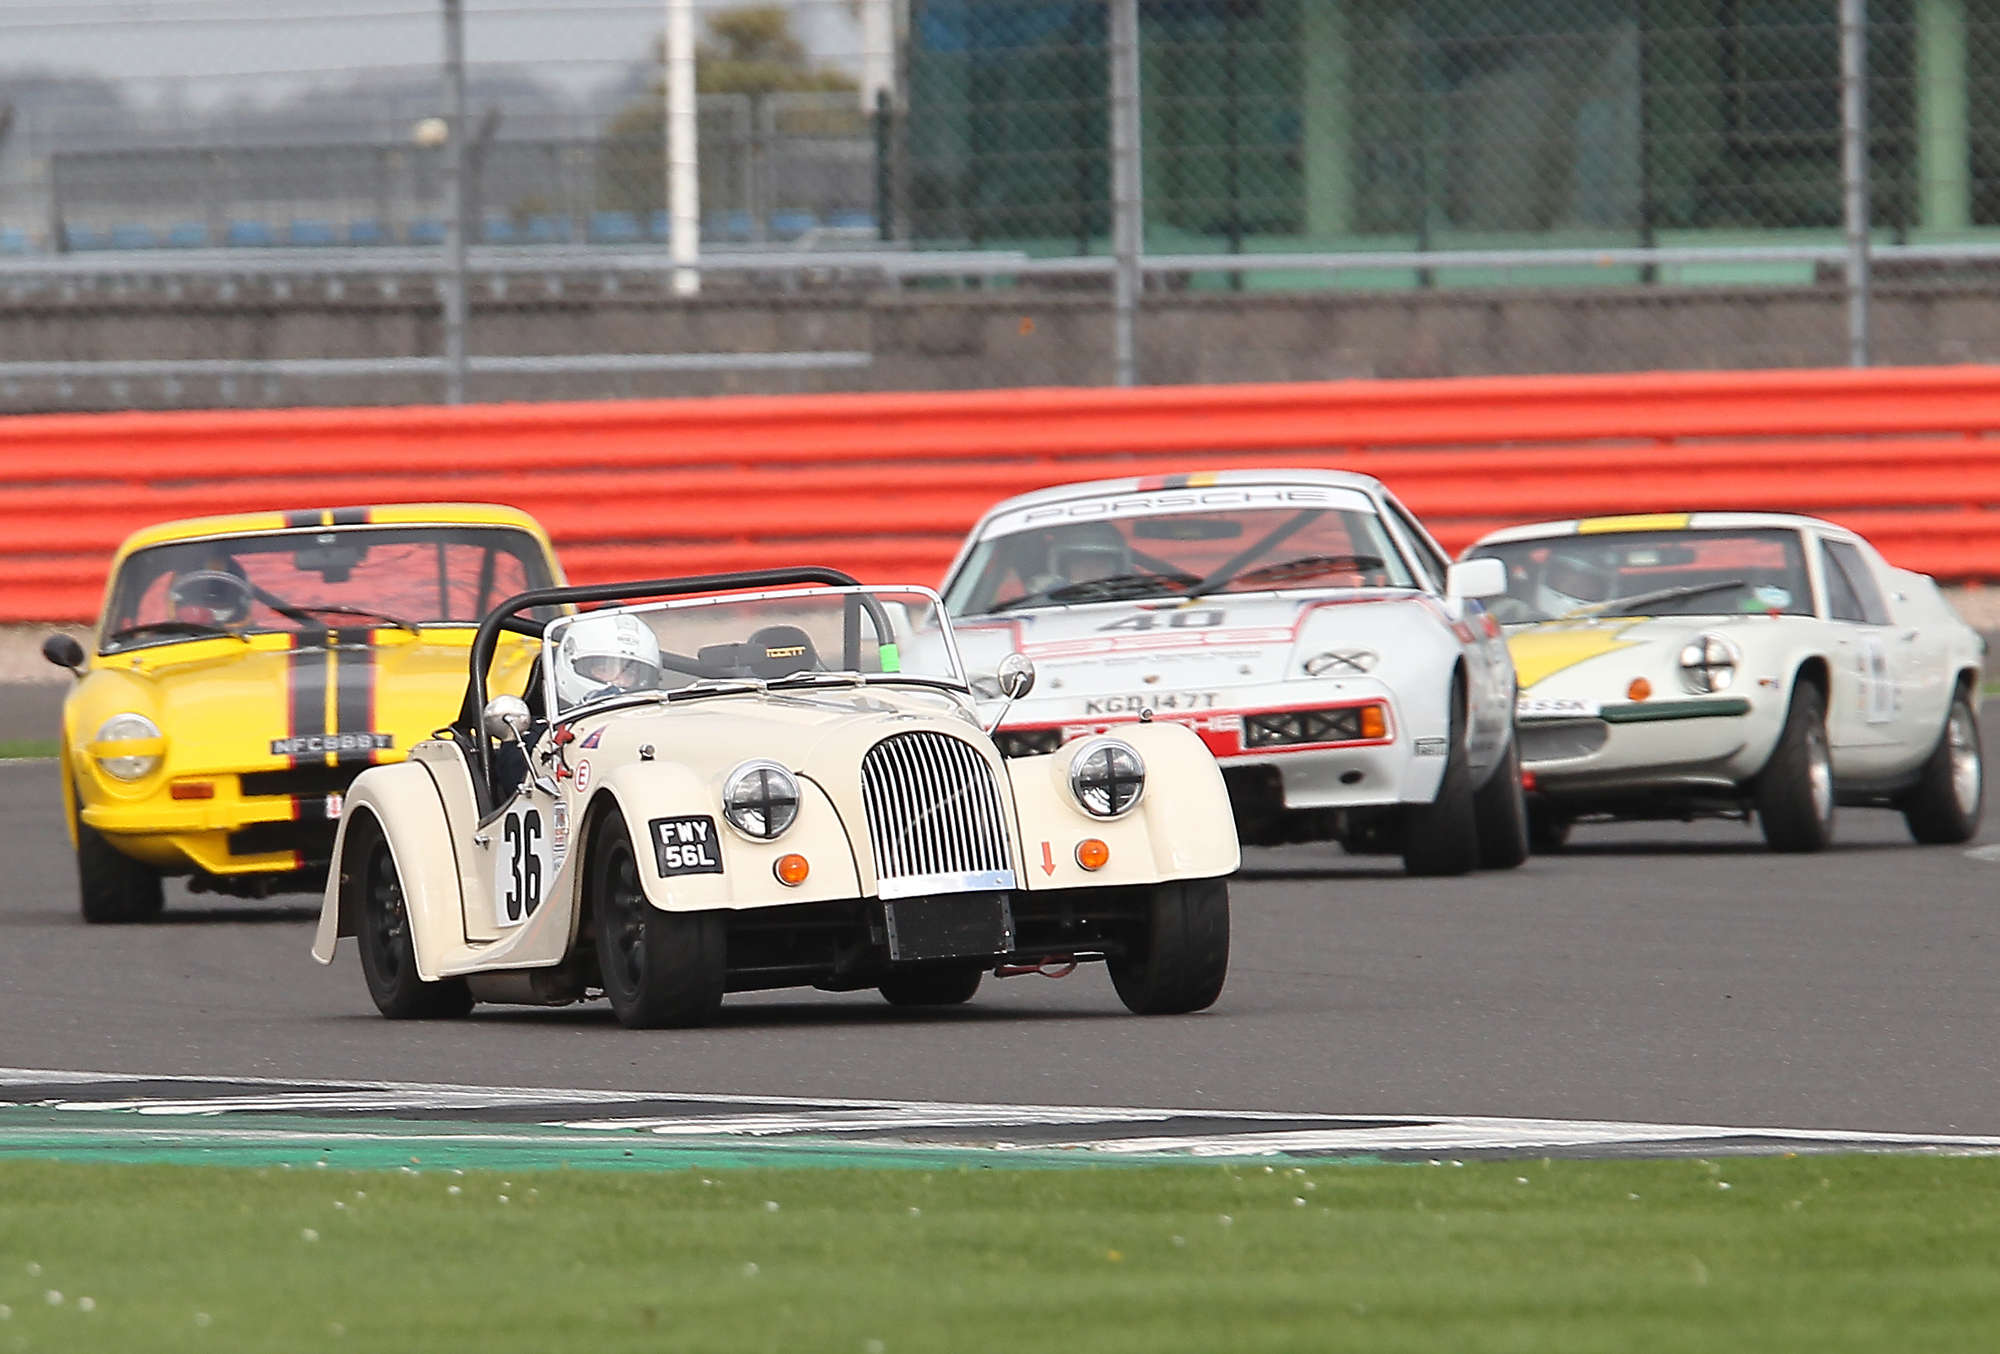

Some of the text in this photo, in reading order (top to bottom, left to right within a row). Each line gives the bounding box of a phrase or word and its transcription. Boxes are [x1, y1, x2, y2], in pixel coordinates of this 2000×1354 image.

[1025, 491, 1329, 523] PORSCHE
[1097, 609, 1223, 631] 40
[659, 821, 708, 844] FWY
[504, 809, 542, 921] 36
[666, 843, 716, 868] 56L
